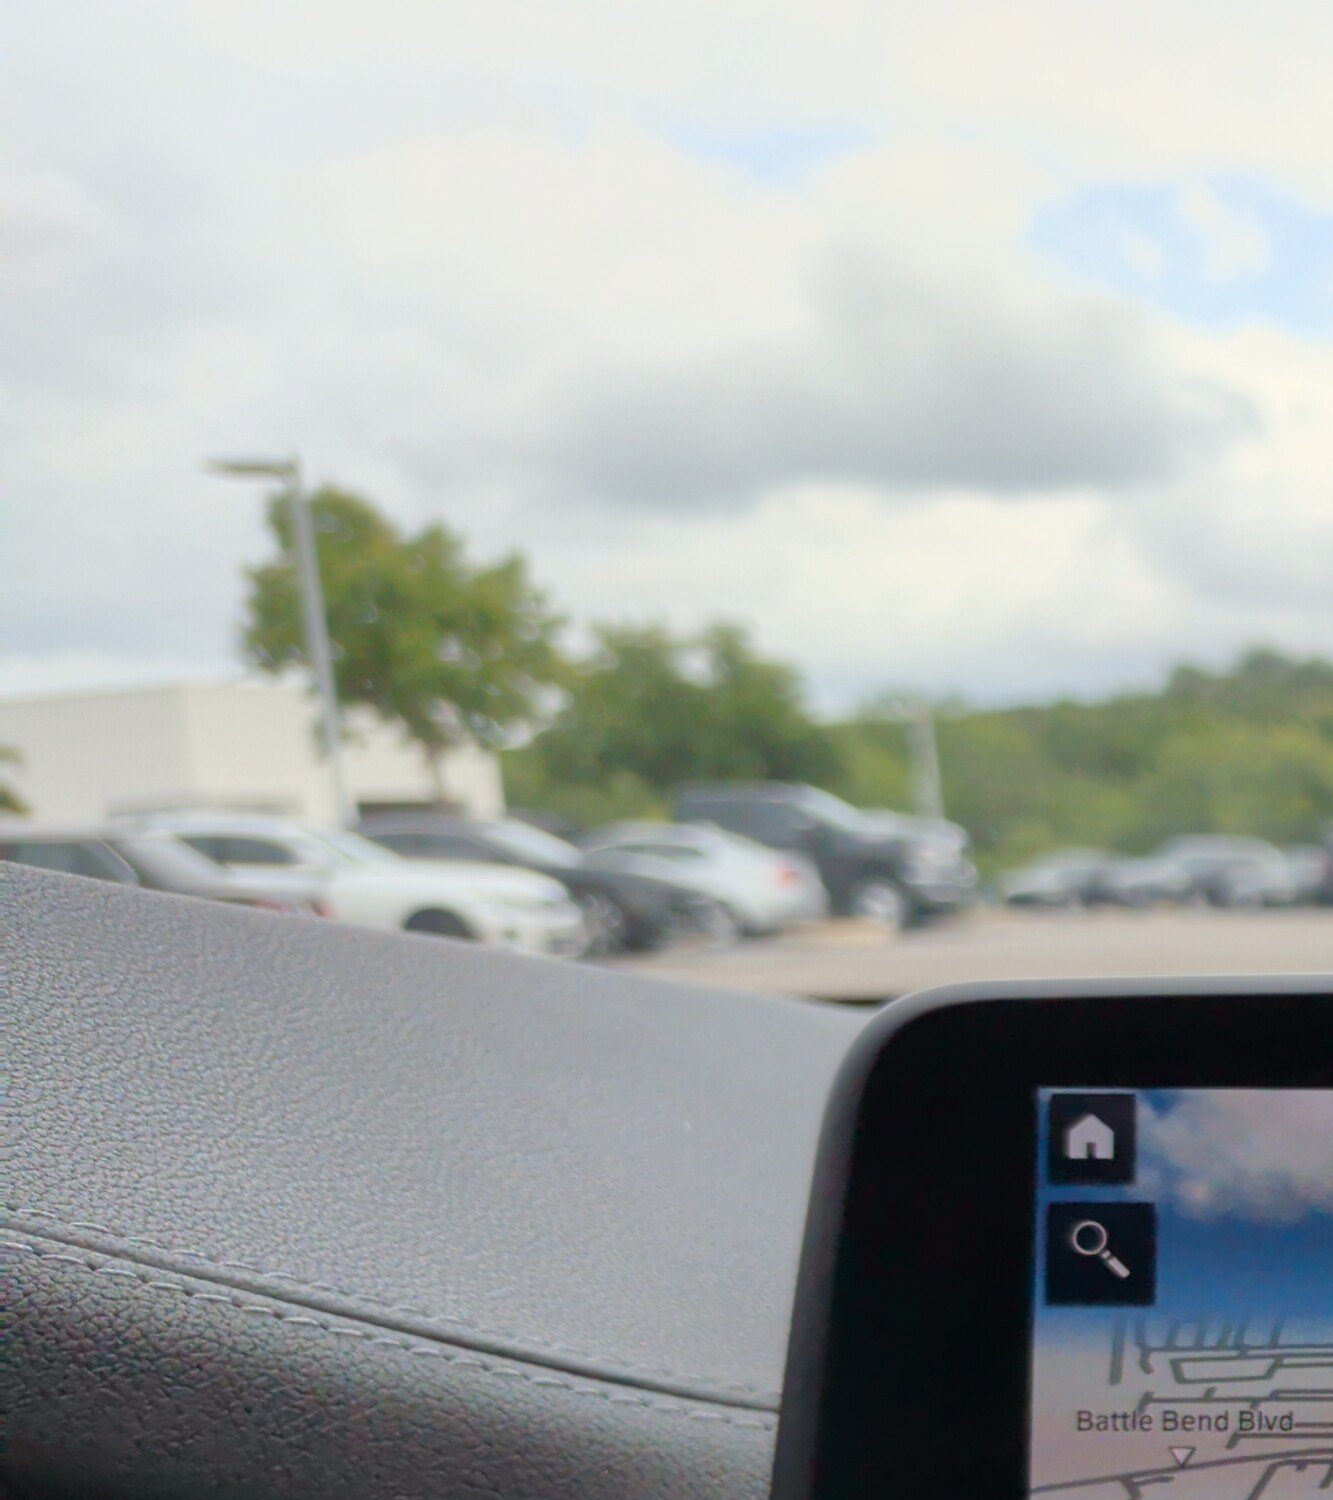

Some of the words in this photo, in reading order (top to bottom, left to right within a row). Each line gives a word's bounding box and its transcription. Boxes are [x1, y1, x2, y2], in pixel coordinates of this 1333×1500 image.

[1076, 1409, 1153, 1432] Battle
[1162, 1409, 1229, 1432] Bend
[1238, 1409, 1294, 1432] Blvd
